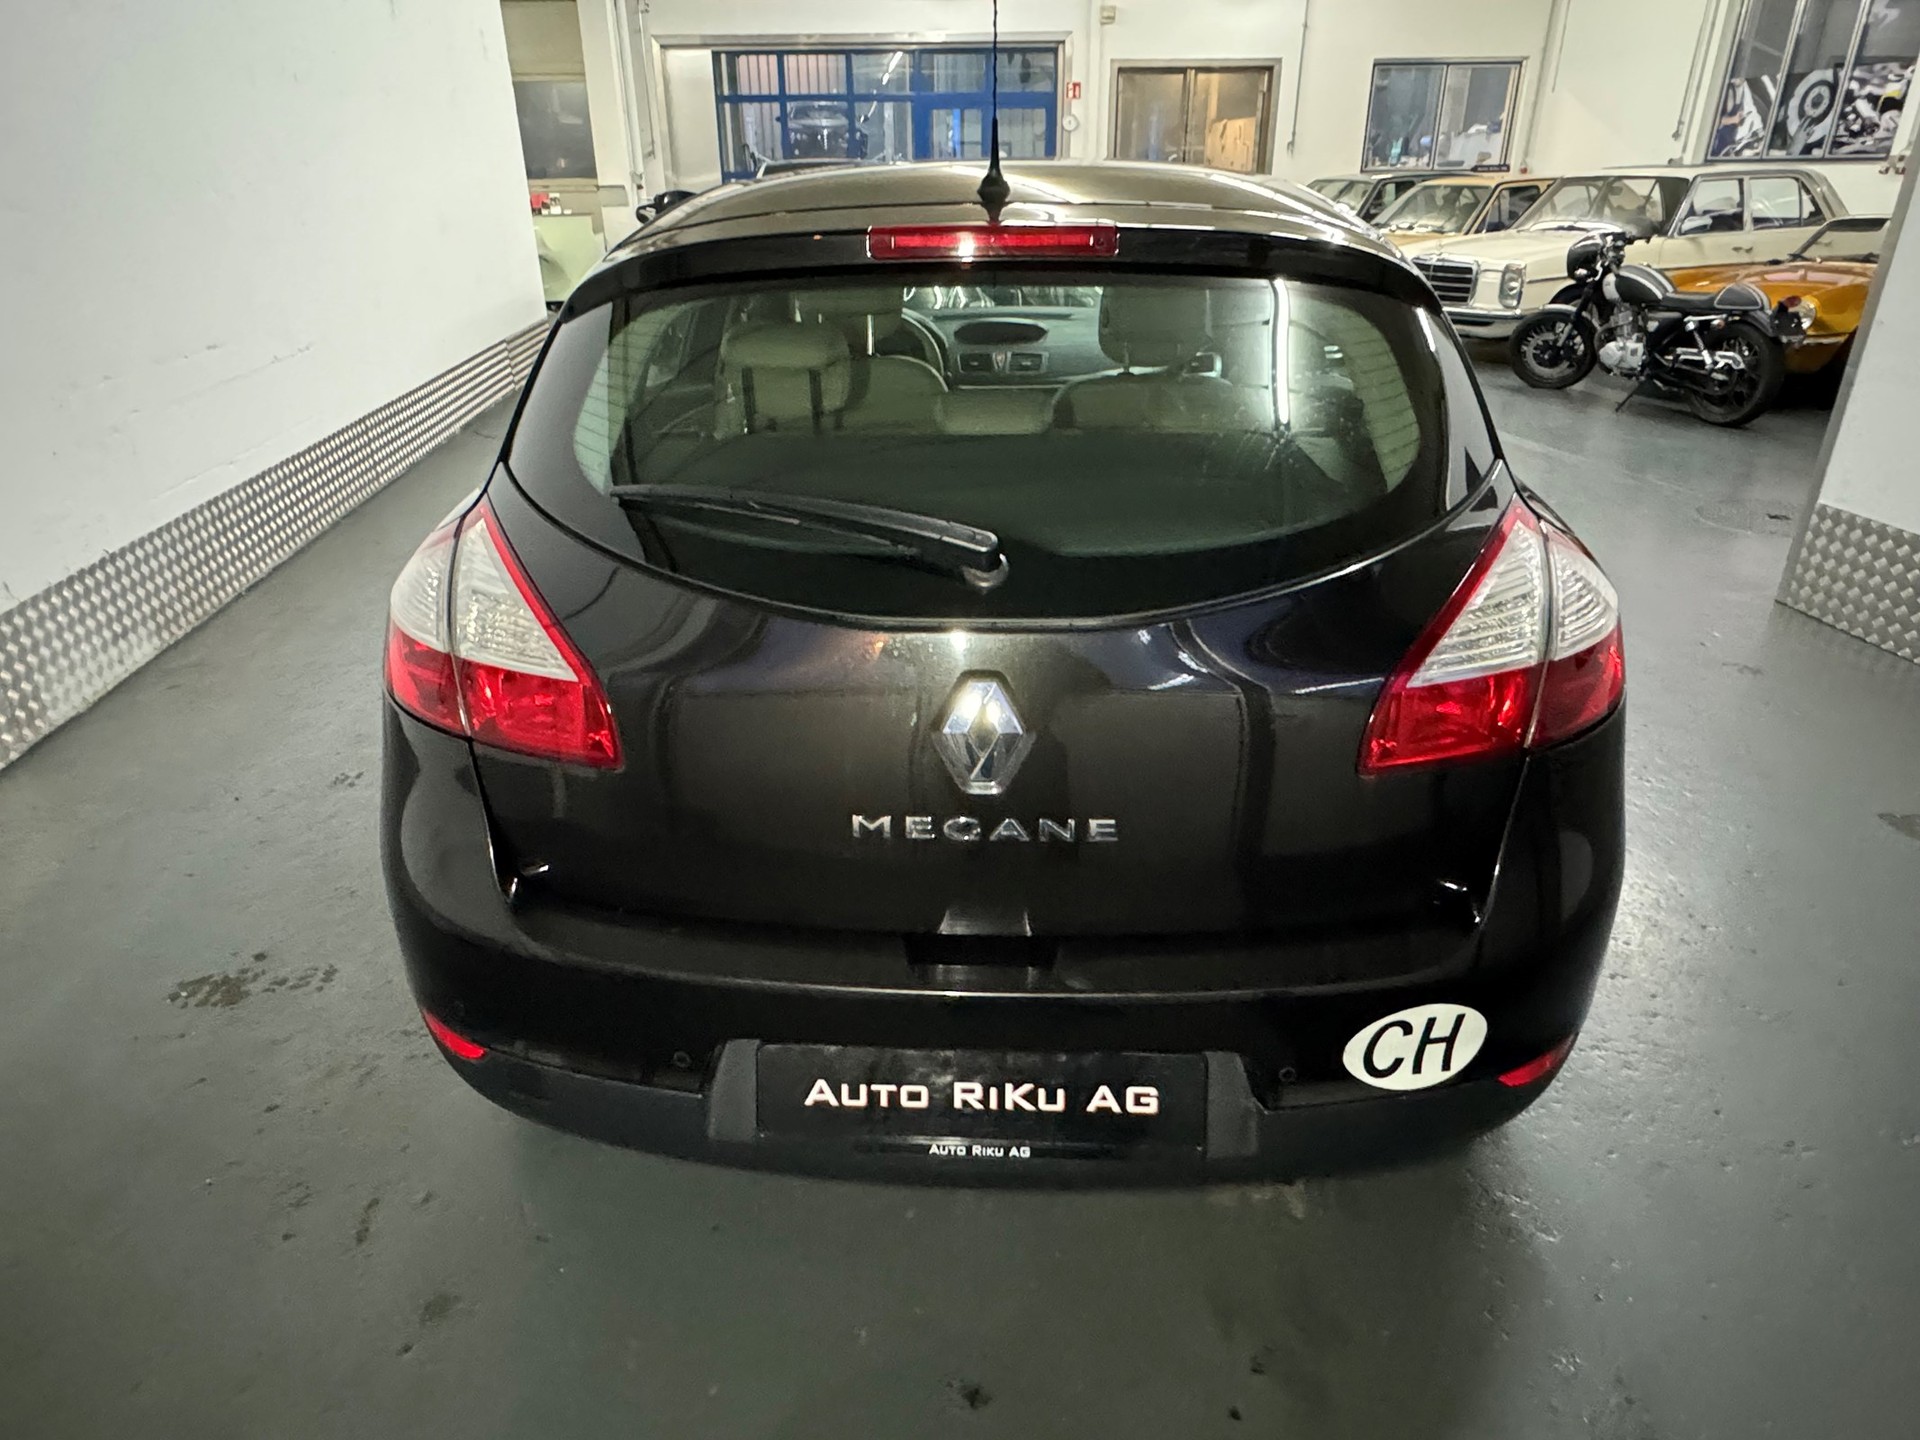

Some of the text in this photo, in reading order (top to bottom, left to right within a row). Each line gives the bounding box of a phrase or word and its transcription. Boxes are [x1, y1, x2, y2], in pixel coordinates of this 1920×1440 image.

[851, 813, 1118, 842] MEGANE
[1362, 1013, 1467, 1079] CH
[804, 1078, 929, 1109] AUTO
[1086, 1085, 1160, 1115] AG
[929, 1143, 967, 1156] AUTO
[1009, 1146, 1031, 1158] AG
